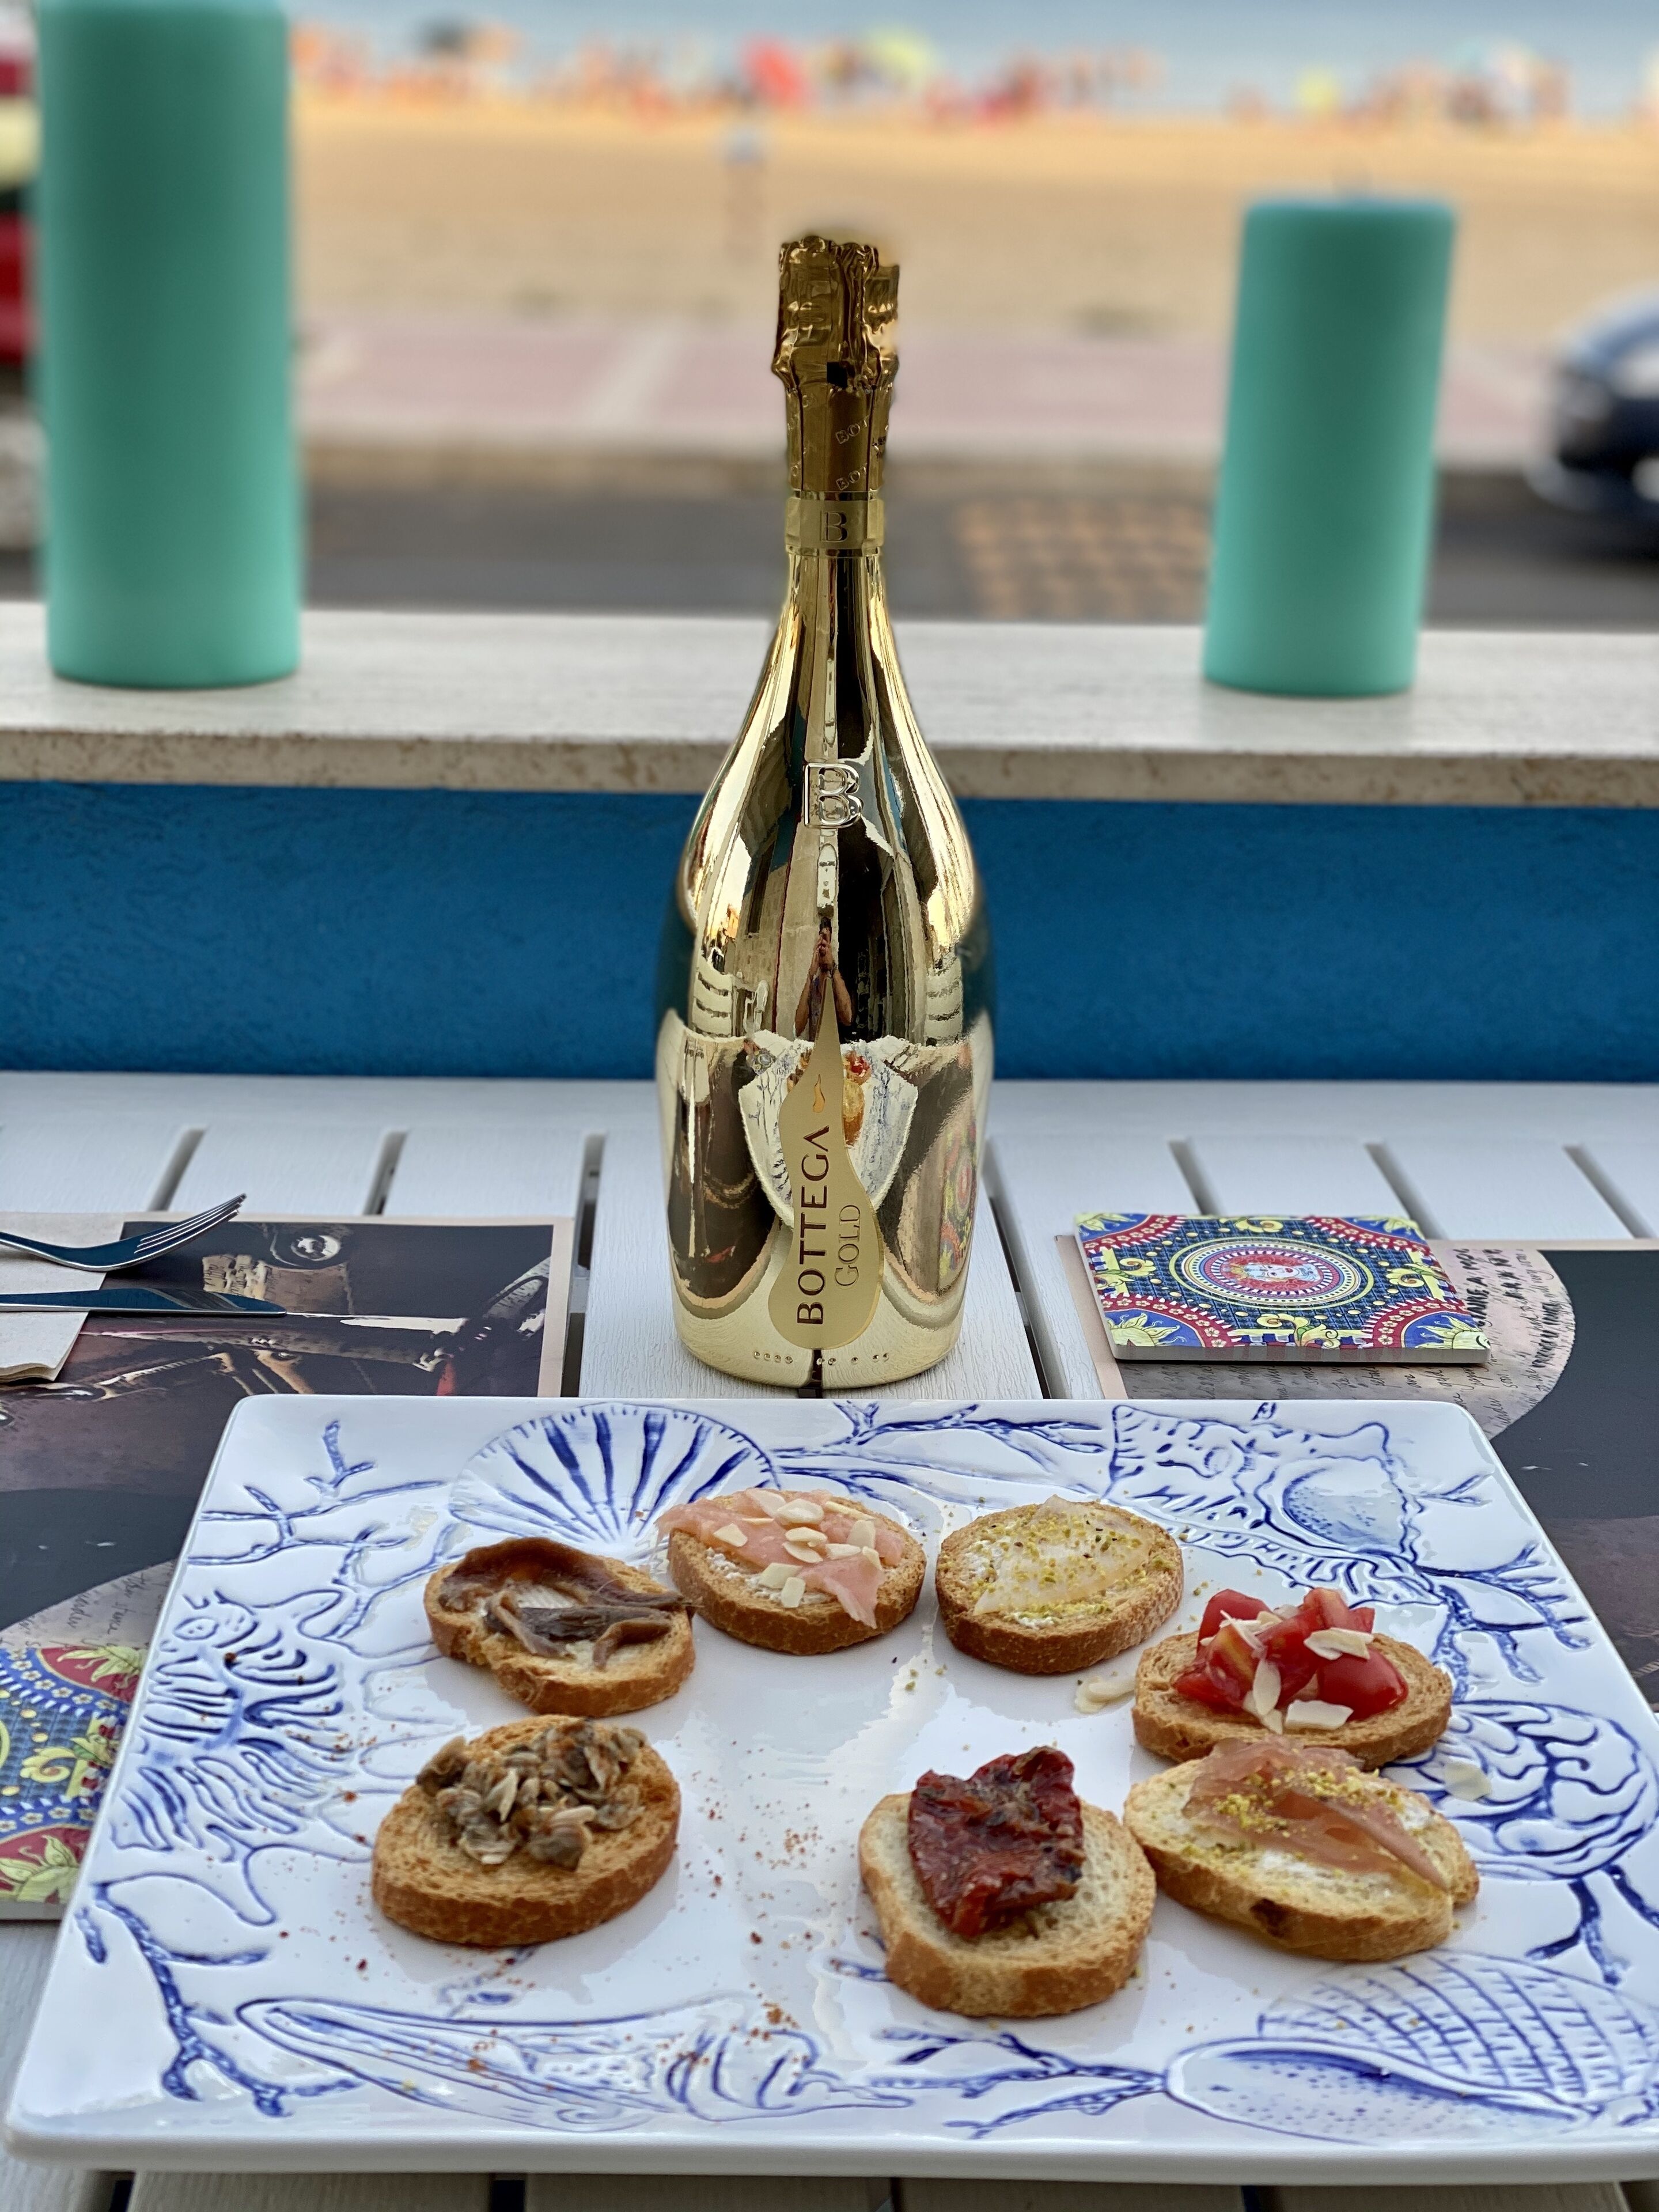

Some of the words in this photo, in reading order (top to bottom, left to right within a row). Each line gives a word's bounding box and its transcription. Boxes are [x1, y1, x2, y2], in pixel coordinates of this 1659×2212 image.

[820, 510, 849, 543] B
[804, 762, 863, 828] B
[797, 1124, 830, 1325] BOTTEGA
[835, 1205, 861, 1287] GOLD
